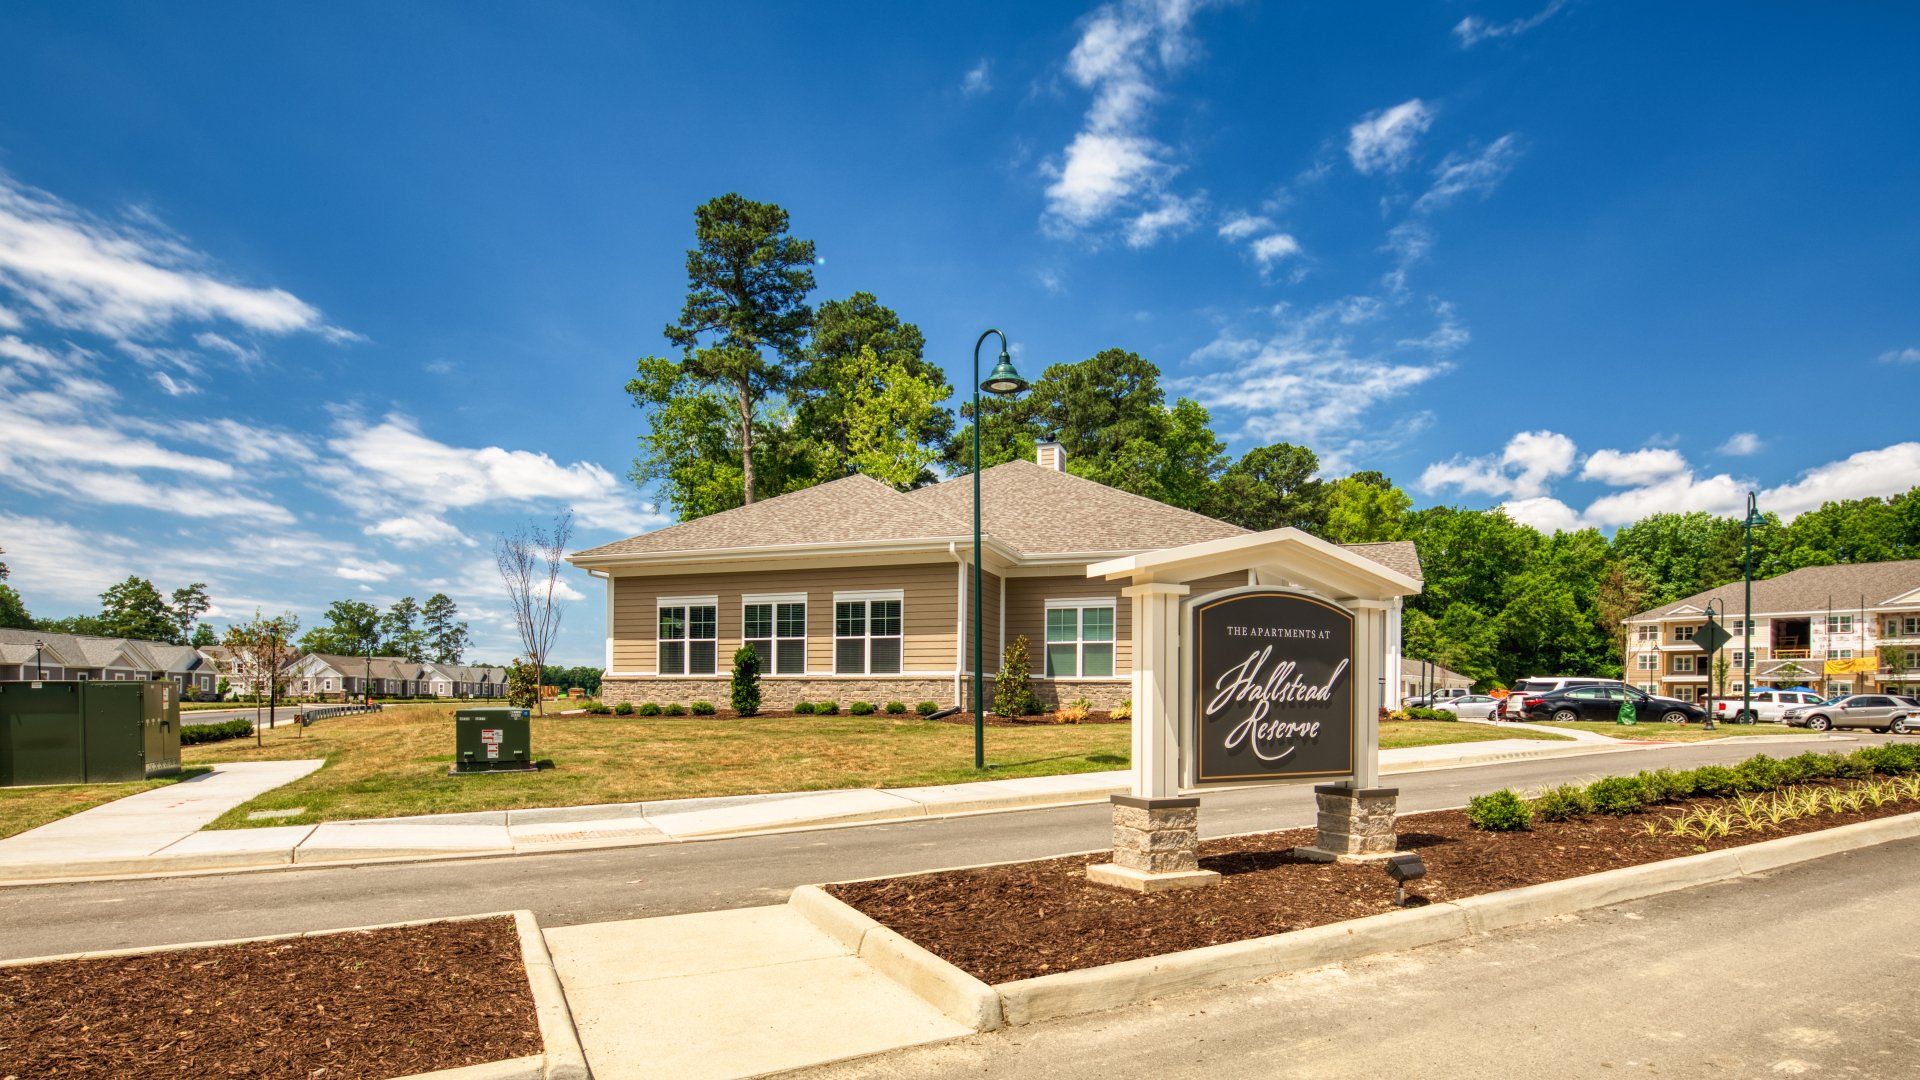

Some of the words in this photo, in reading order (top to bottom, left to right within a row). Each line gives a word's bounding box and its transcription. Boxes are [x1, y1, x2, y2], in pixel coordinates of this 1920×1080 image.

[1227, 626, 1248, 636] THE
[1251, 627, 1316, 639] APARTMENTS
[1318, 630, 1331, 639] AT
[1206, 645, 1349, 715] Hallstead
[1224, 699, 1320, 761] Reserve
